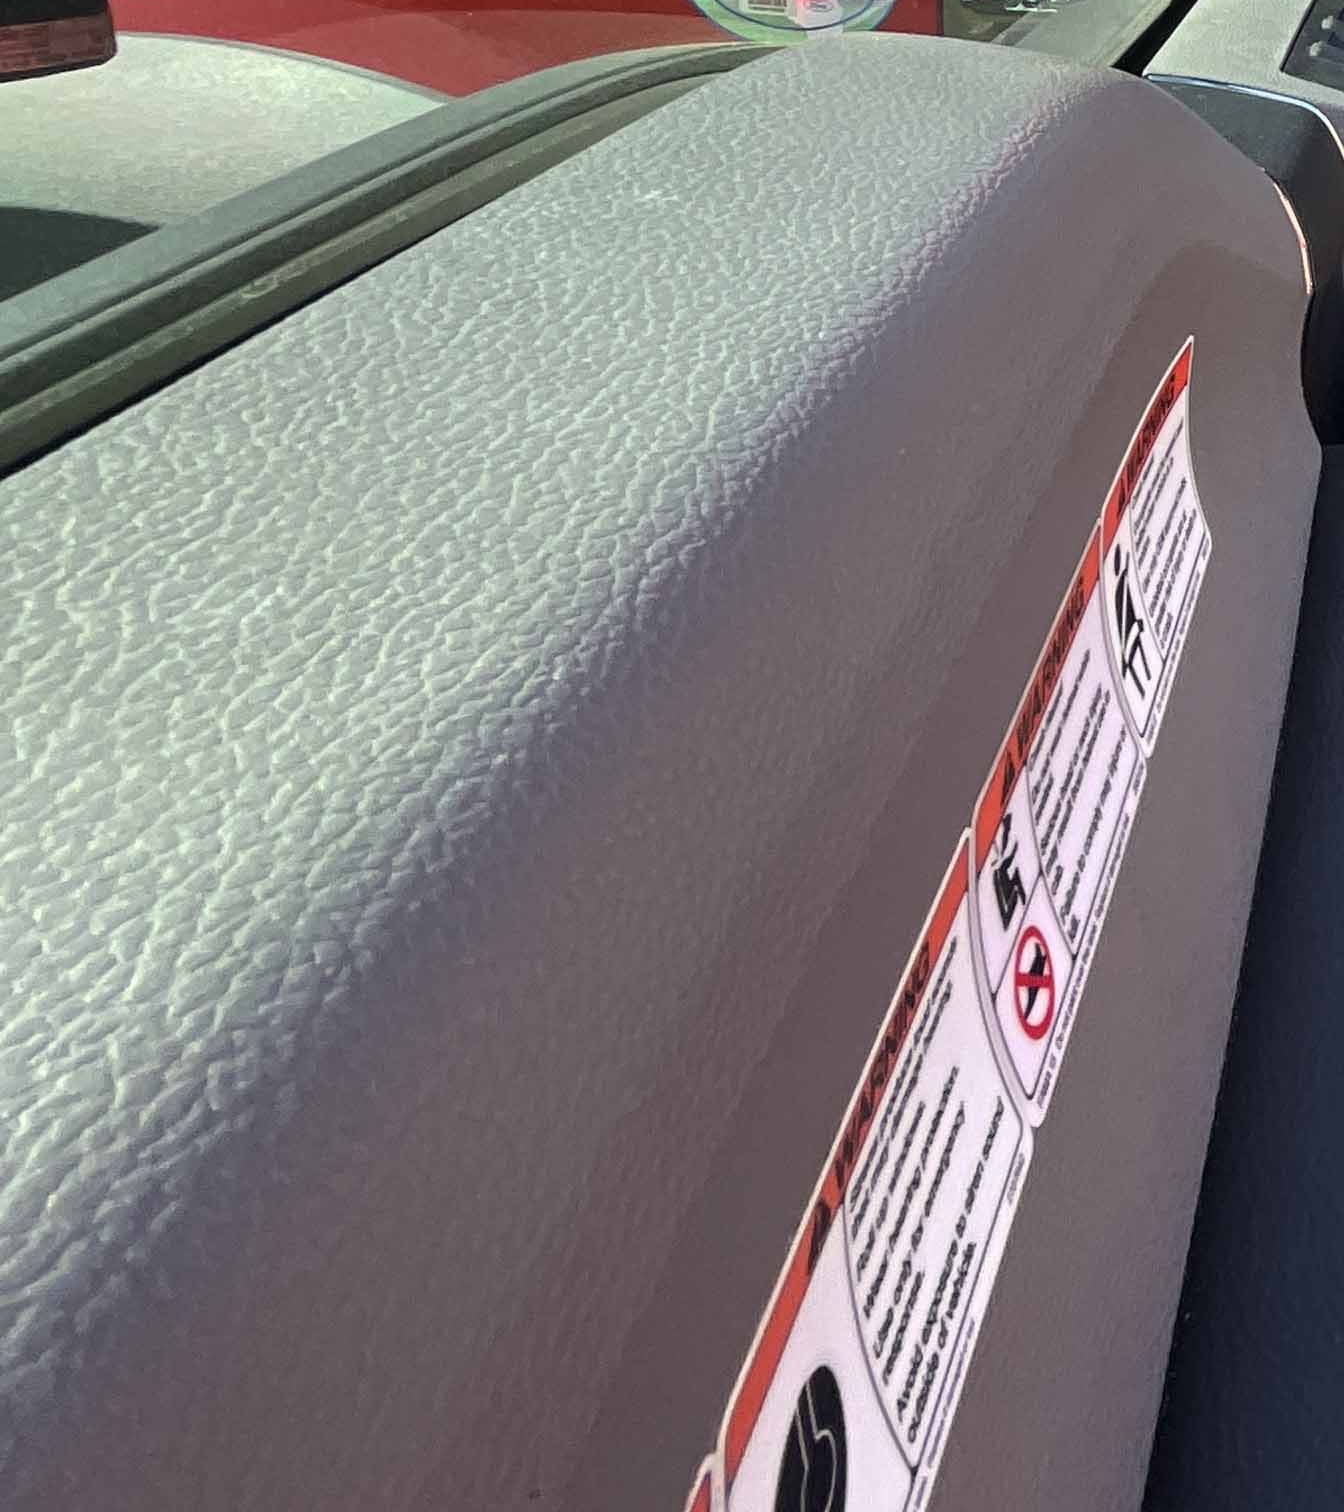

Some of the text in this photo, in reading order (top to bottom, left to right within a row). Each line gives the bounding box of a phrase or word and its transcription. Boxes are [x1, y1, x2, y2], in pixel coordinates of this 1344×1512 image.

[1017, 574, 1085, 761] WARNING
[836, 940, 930, 1186] WARNING
[873, 1104, 964, 1359] Use only for emergency
[889, 1166, 921, 1253] hearing
[897, 1344, 923, 1422] Avoid
[922, 1240, 958, 1345] exposure
[965, 1161, 984, 1214] siren
[983, 1096, 1004, 1160] sound
[908, 1352, 939, 1443] outside
